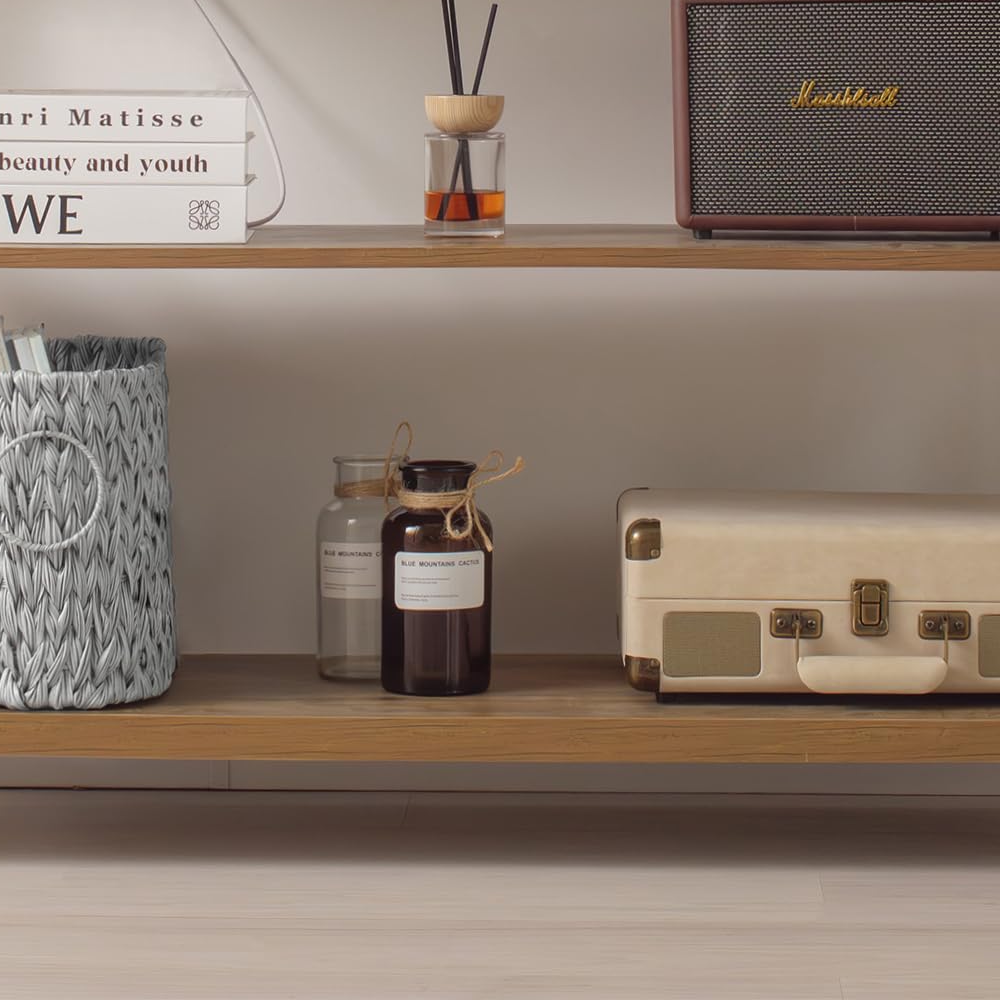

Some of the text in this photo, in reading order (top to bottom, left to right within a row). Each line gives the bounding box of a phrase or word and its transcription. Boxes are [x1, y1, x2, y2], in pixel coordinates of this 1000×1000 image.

[68, 108, 204, 128] Matisse
[86, 153, 129, 173] and
[139, 154, 209, 177] youth
[401, 559, 416, 567] BLUE
[418, 560, 456, 568] MOUNTAINS
